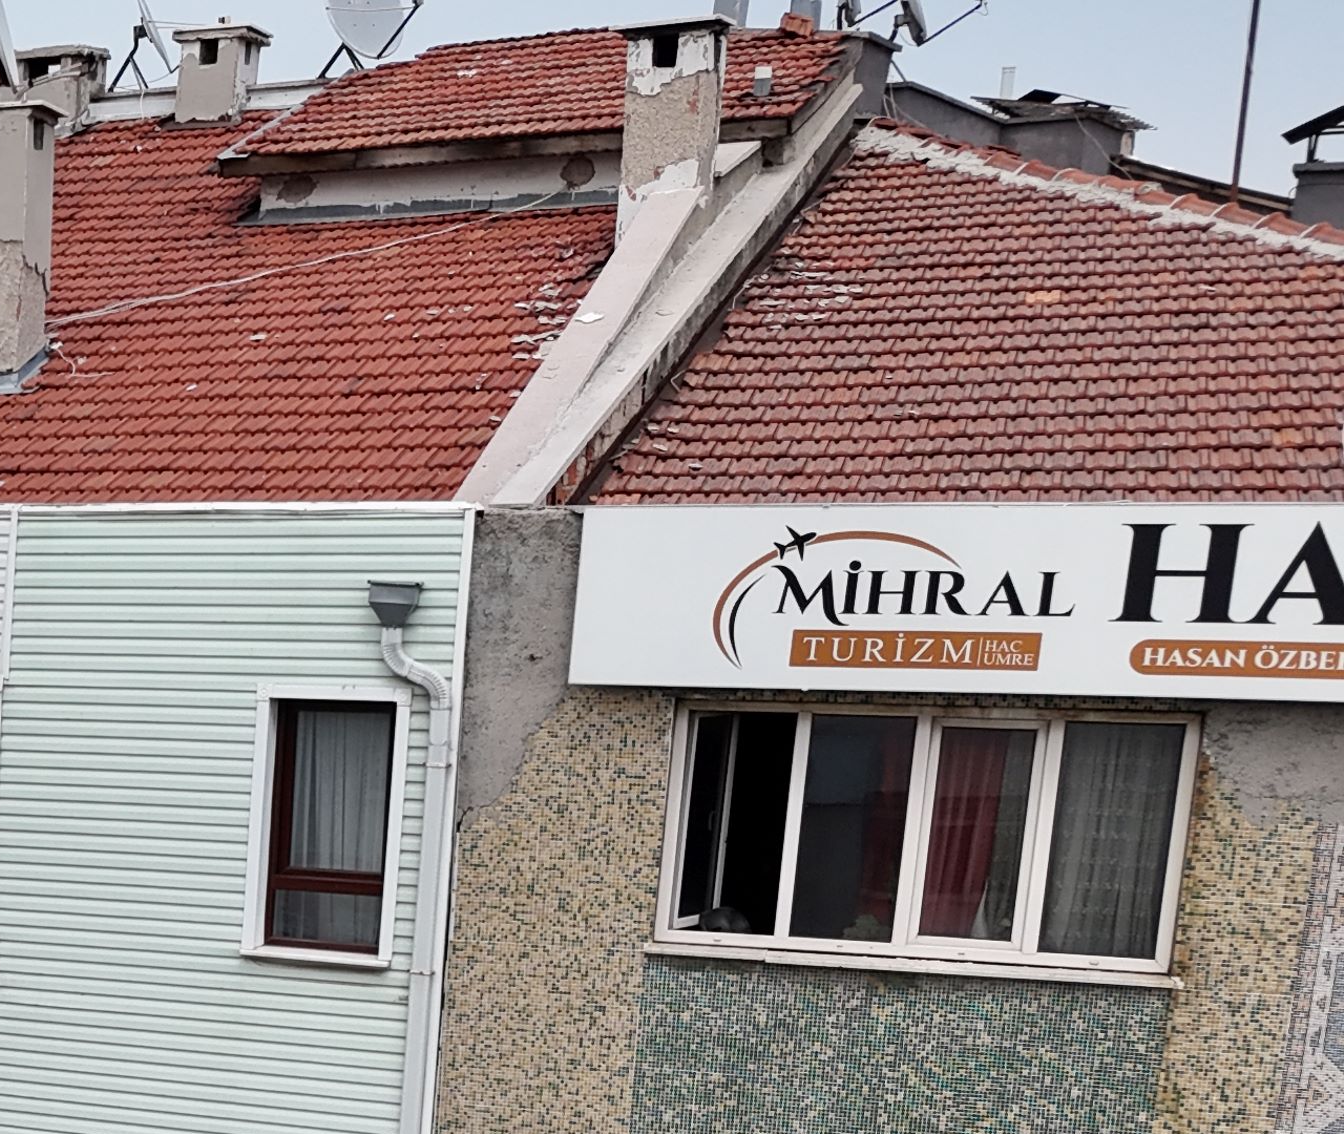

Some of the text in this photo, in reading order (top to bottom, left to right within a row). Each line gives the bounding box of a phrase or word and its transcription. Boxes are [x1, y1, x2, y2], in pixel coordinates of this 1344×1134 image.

[771, 560, 1076, 626] MİHRAL
[803, 632, 975, 665] TURİZM
[985, 640, 1023, 652] HAC
[1142, 645, 1344, 670] HASAN ÖZBE
[983, 653, 1034, 666] UMRE
